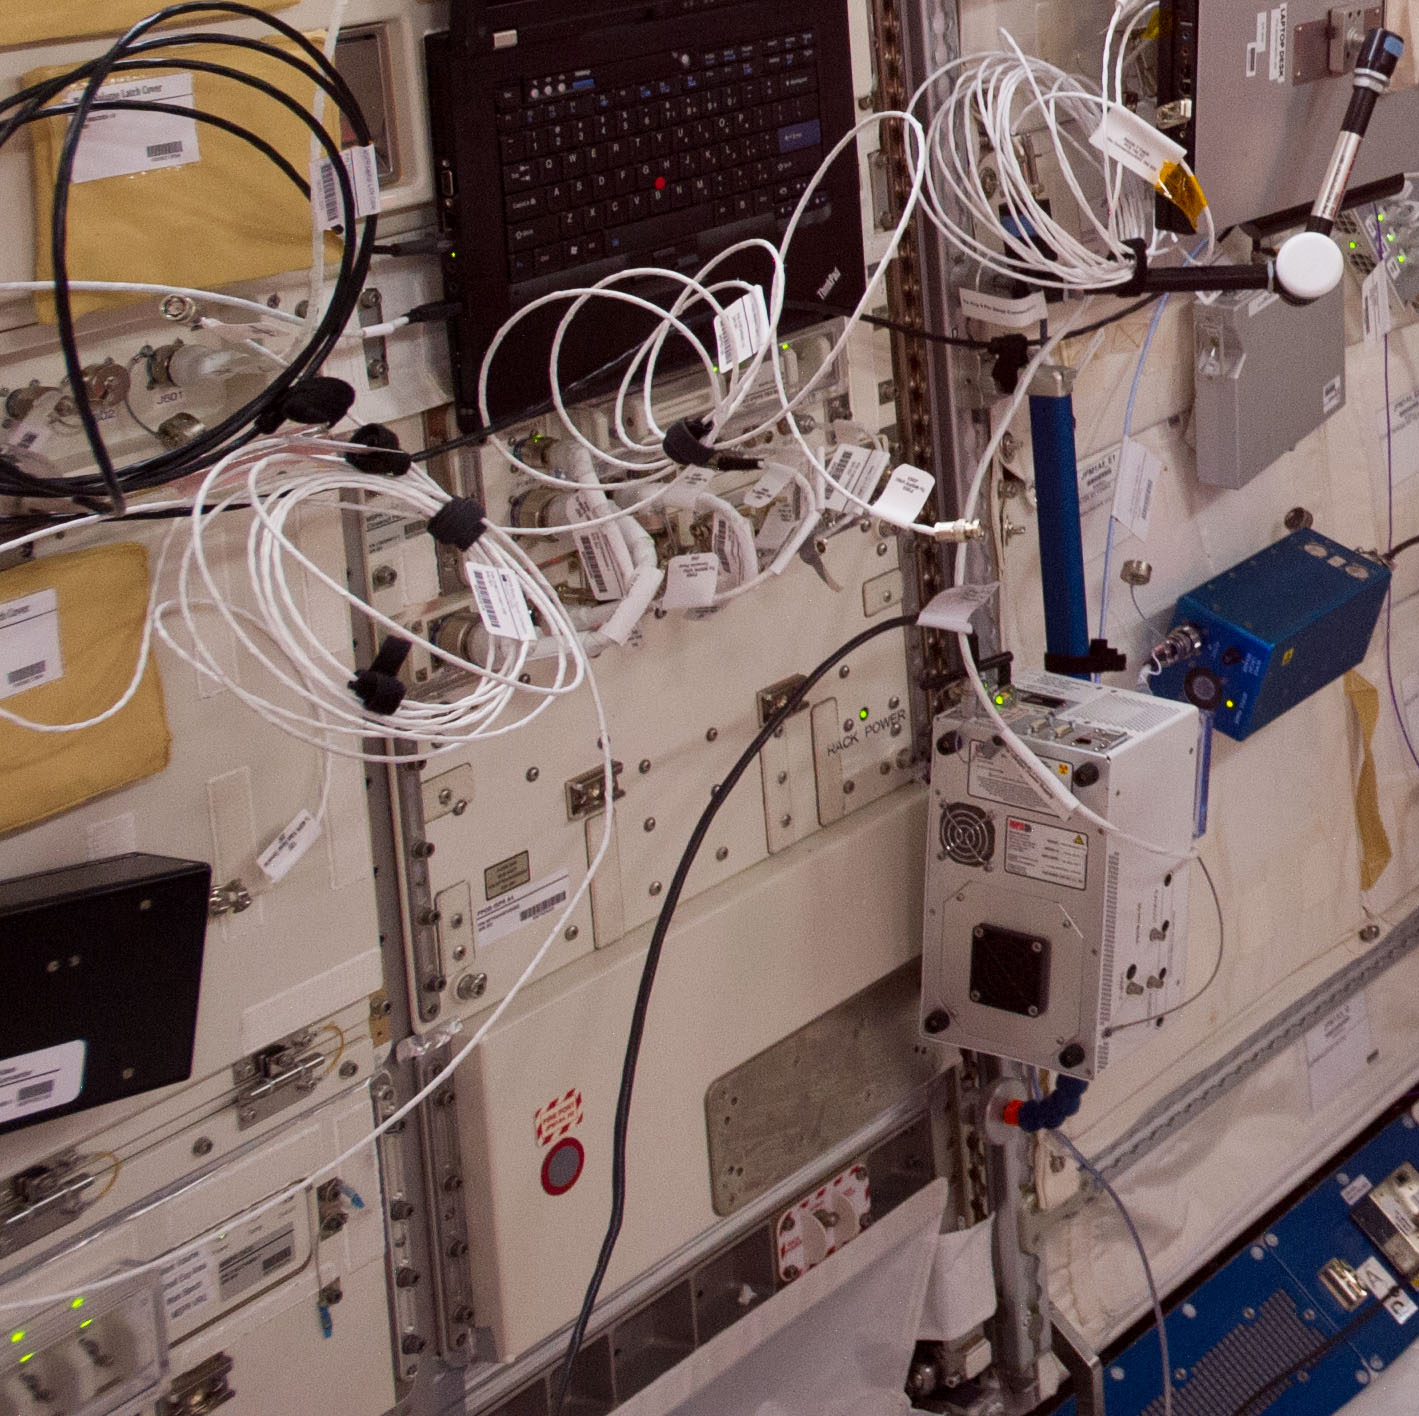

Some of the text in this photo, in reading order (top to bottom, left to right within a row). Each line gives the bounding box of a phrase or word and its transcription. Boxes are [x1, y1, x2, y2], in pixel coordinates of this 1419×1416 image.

[816, 266, 841, 301] ThinkPad
[865, 708, 906, 738] POWER
[1366, 1267, 1387, 1287] A
